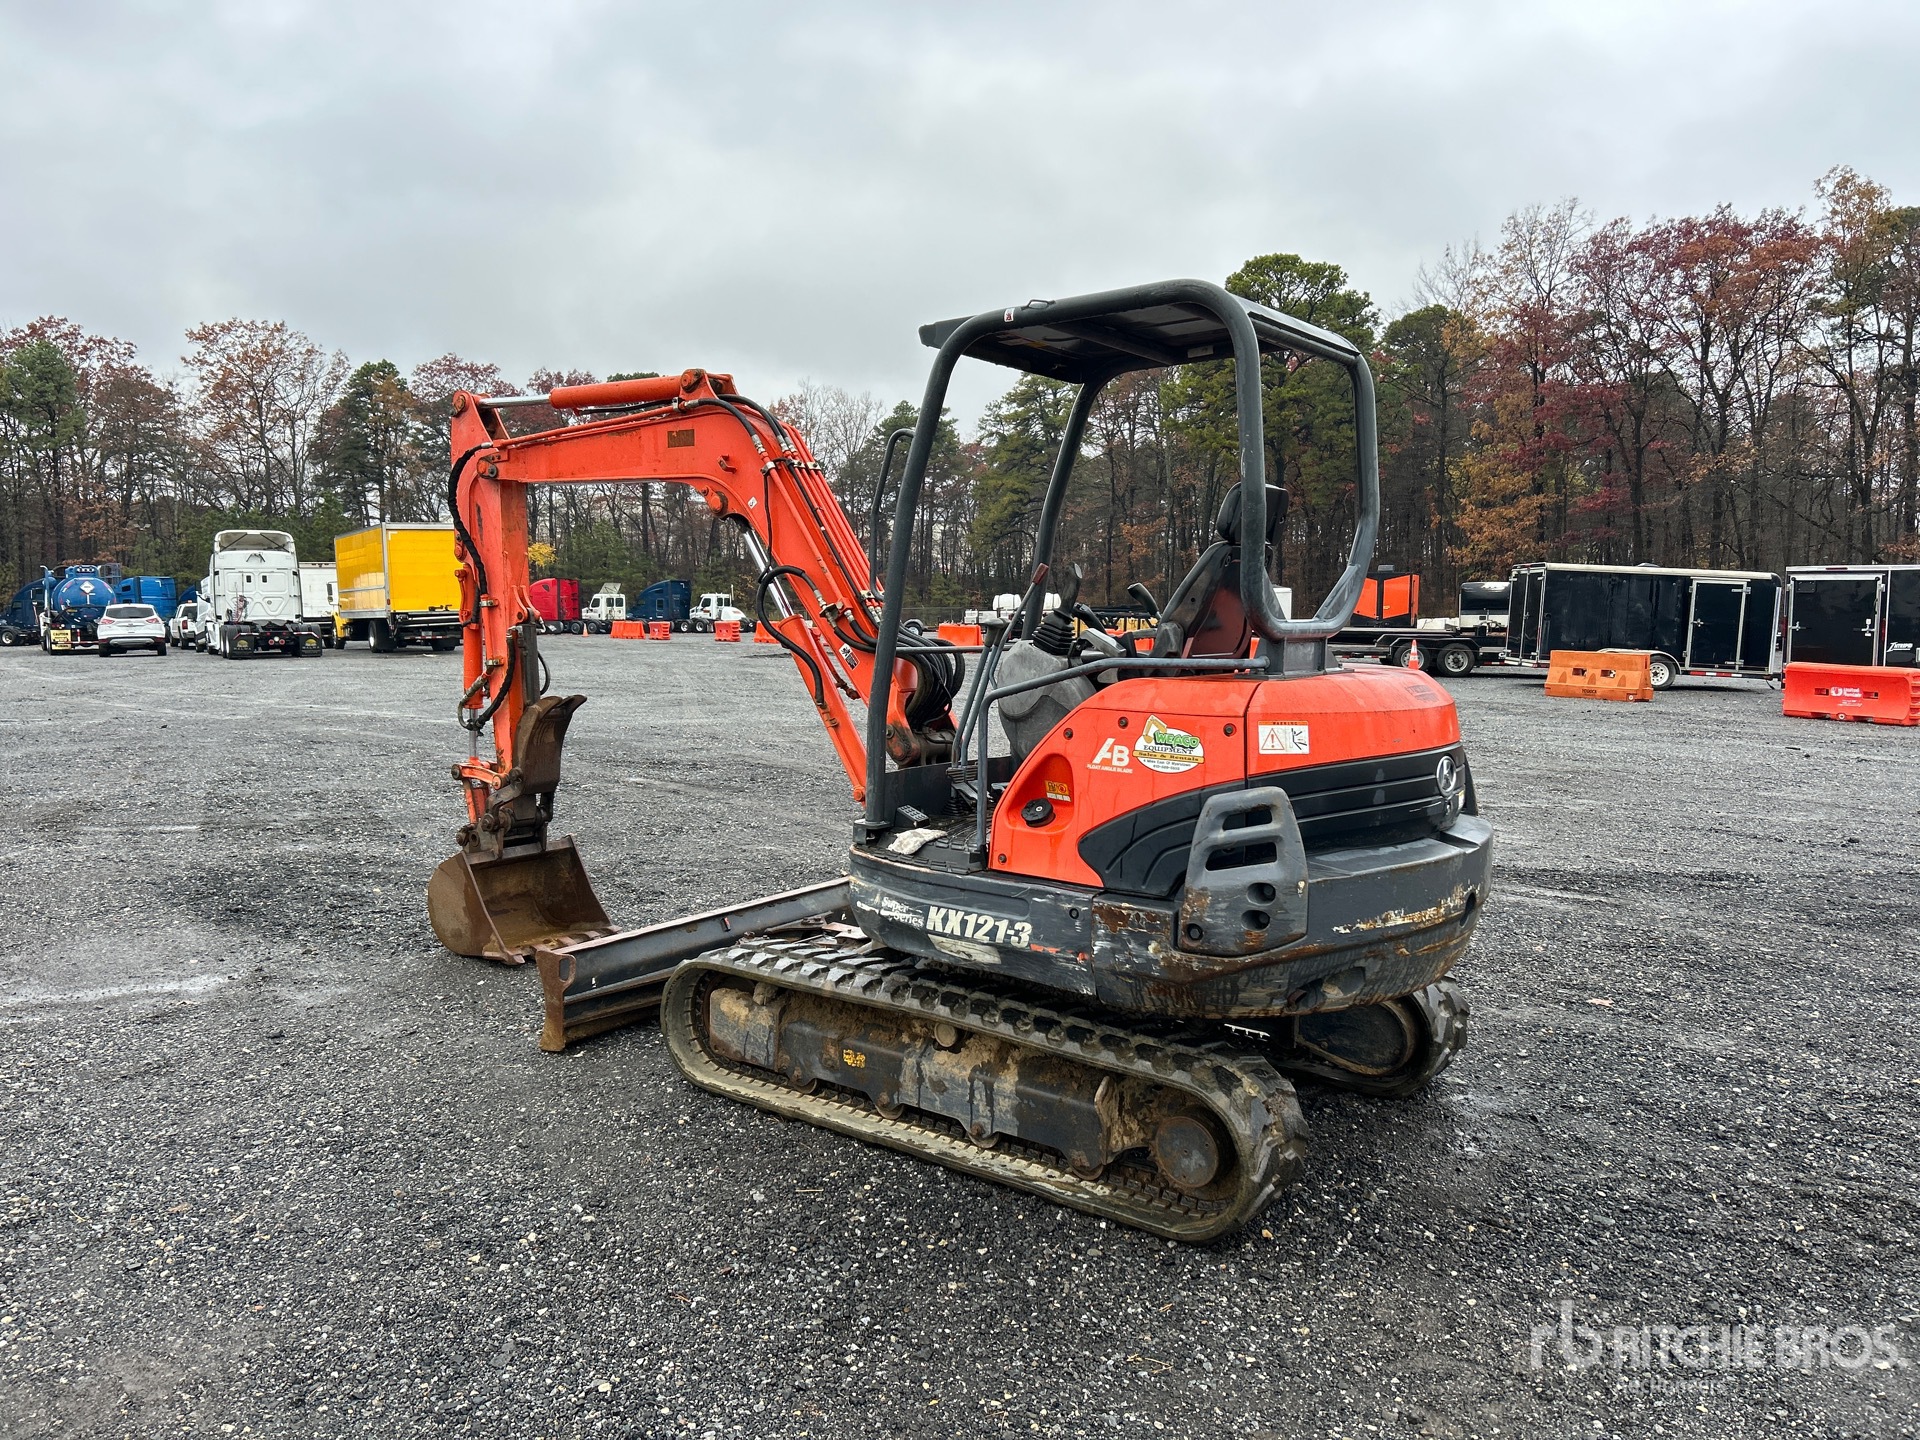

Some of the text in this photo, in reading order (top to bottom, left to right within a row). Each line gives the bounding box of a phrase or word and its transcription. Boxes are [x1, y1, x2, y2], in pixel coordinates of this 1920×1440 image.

[1143, 745, 1194, 755] EQUIPMENT
[881, 896, 909, 912] Super
[893, 910, 925, 928] Series
[926, 905, 1033, 949] KX121-3
